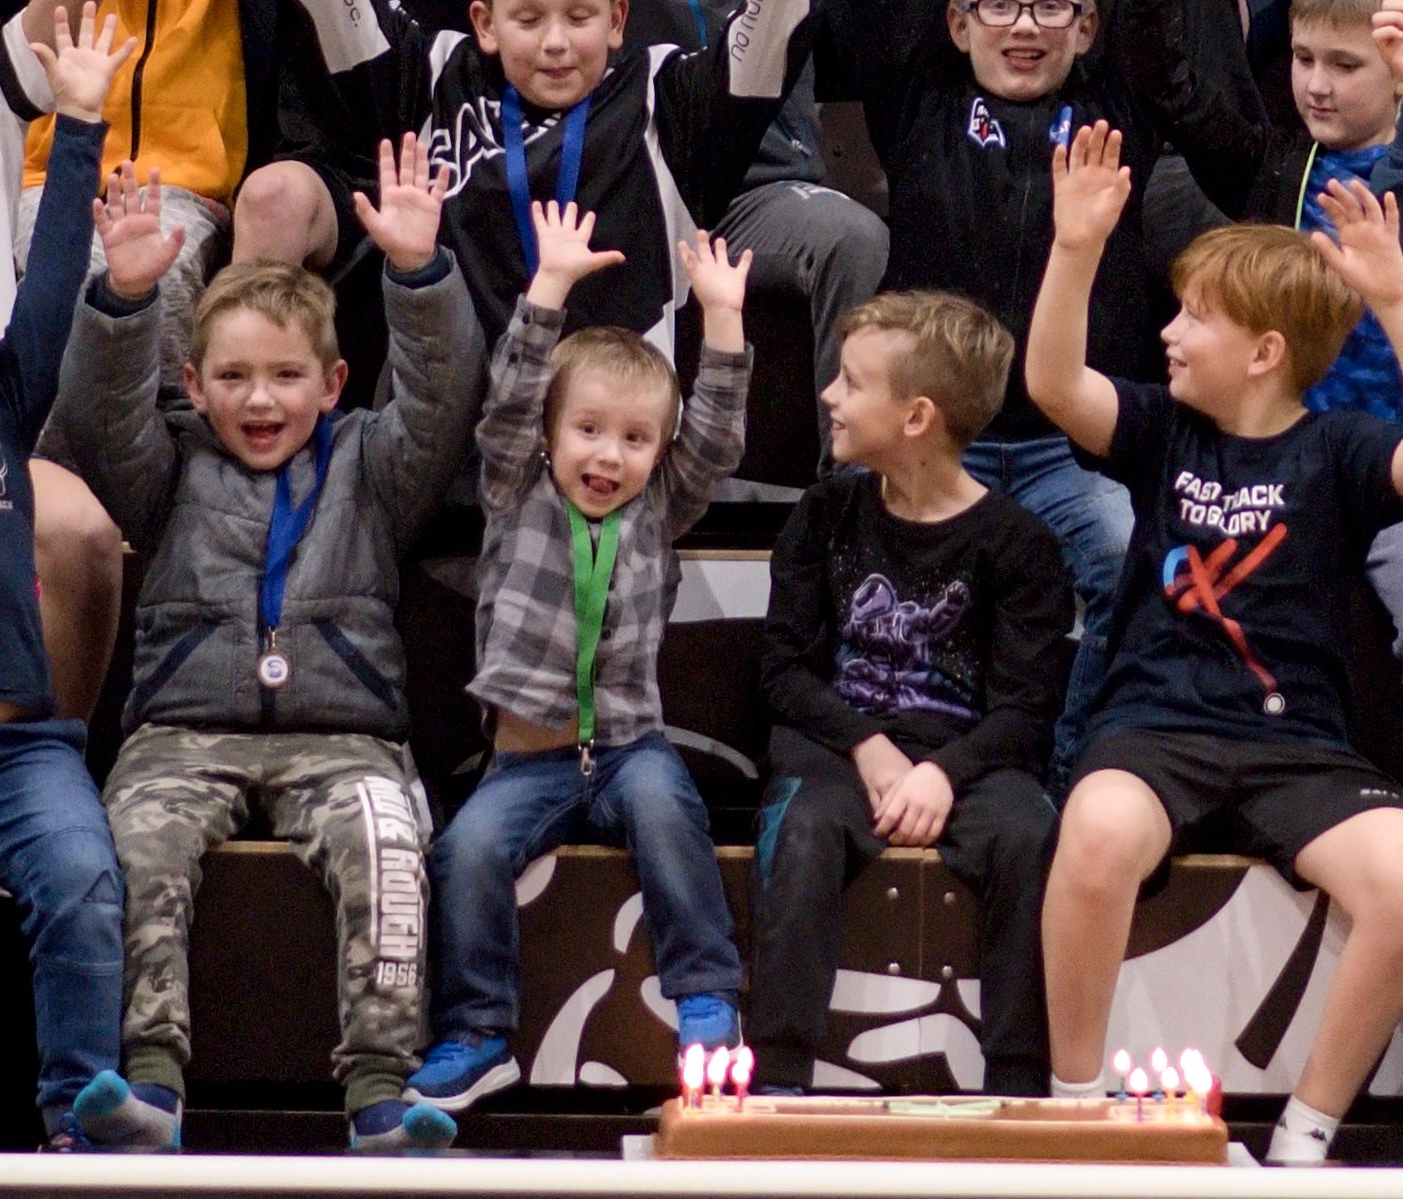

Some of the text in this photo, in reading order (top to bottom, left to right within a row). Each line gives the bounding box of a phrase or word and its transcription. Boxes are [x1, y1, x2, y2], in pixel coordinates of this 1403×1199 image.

[730, 30, 751, 63] no
[1174, 470, 1222, 502] FAST
[1180, 498, 1271, 536] TO GLORY
[379, 848, 419, 958] ROUGH
[377, 960, 418, 986] 1956
